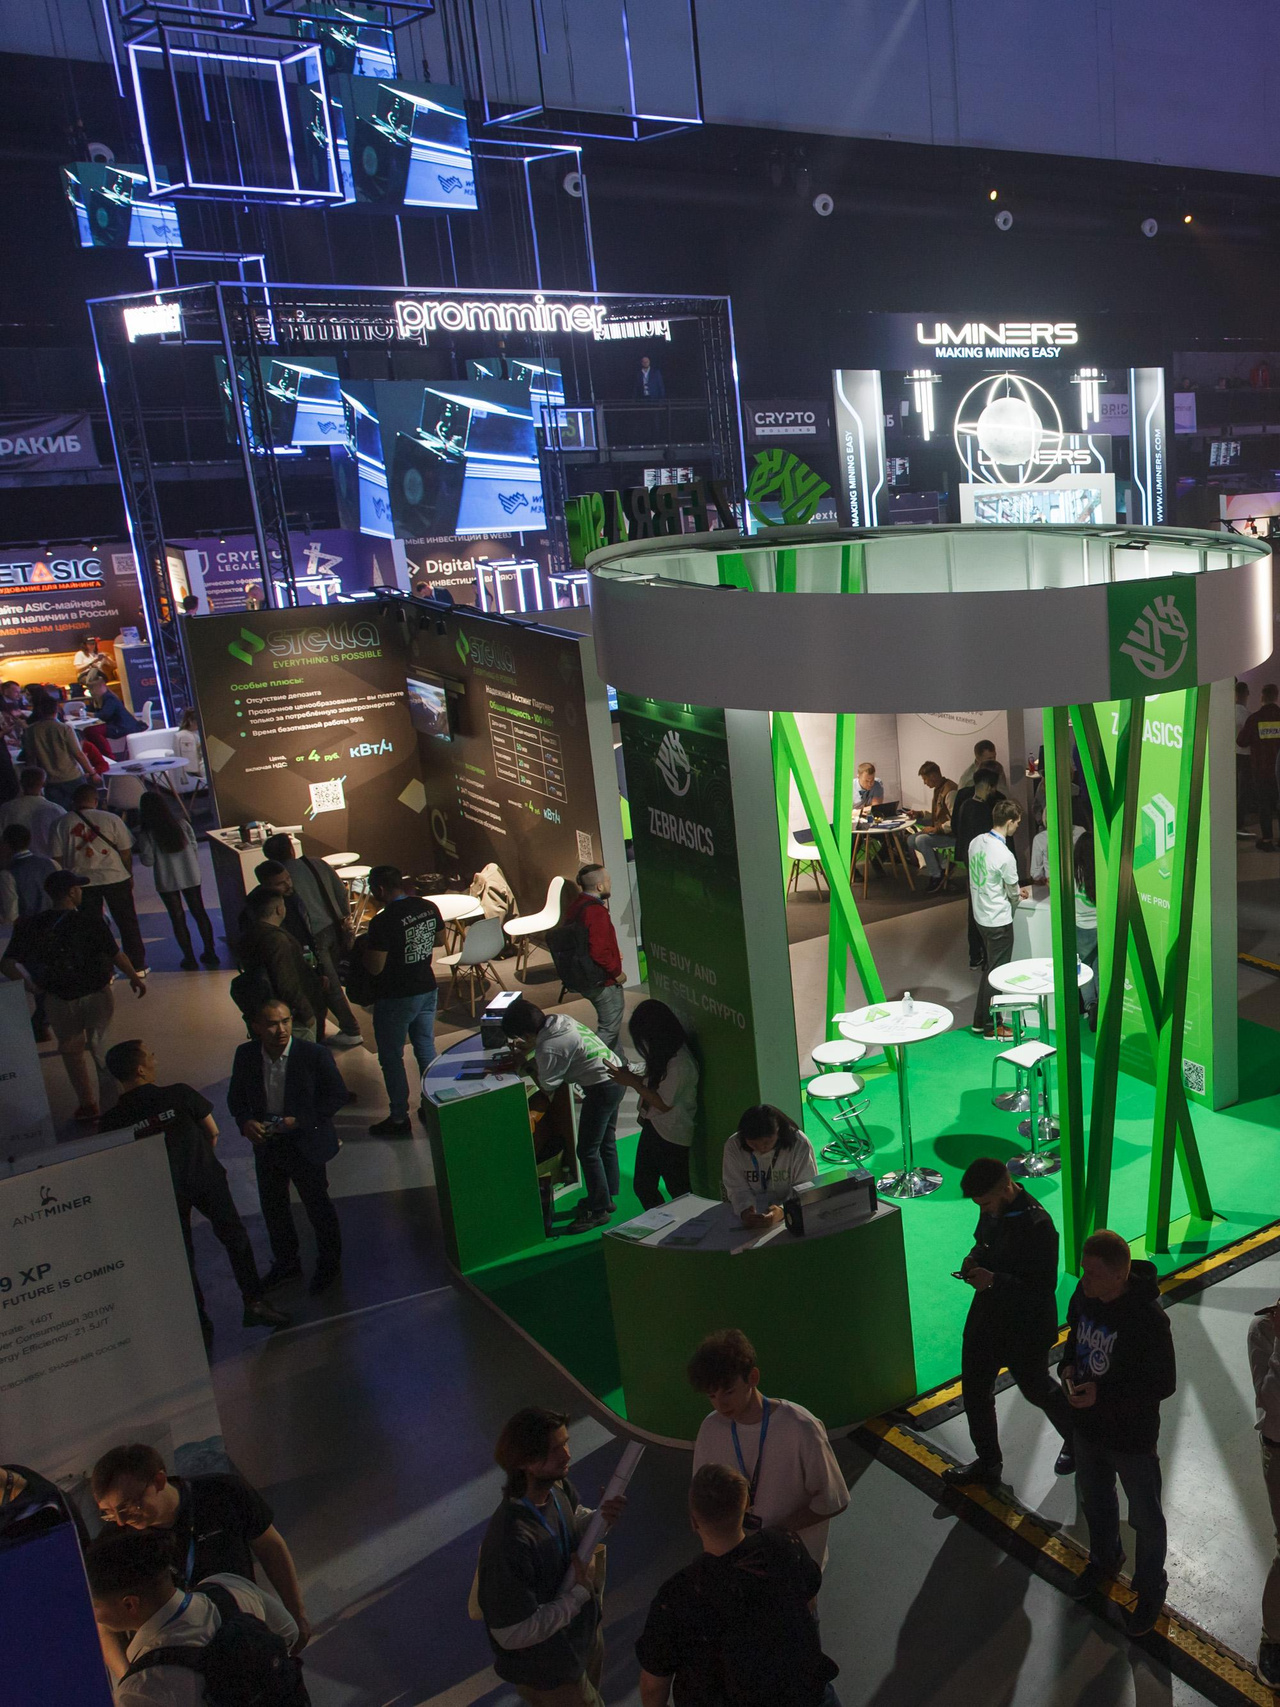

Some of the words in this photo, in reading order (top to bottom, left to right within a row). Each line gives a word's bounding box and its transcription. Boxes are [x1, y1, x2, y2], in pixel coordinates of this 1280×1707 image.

[395, 295, 606, 334] promminer
[916, 322, 1078, 345] UMINERS
[935, 347, 983, 358] MAKING
[985, 347, 1029, 358] MINING
[1032, 347, 1061, 358] EASY
[754, 411, 815, 425] CRYPTO
[0, 435, 81, 456] РАКИБ
[845, 431, 854, 453] EASY
[847, 455, 856, 489] MINING
[1154, 428, 1164, 523] WWW.UMINERS.COM
[850, 490, 859, 527] MAKING
[426, 534, 482, 545] ИНВЕСТИЦИИ
[218, 562, 261, 573] LEGALS
[425, 557, 476, 576] Digital
[21, 611, 70, 624] наличии
[80, 608, 119, 619] России
[25, 599, 106, 612] ASIC-майнеры
[55, 622, 91, 632] ценам
[273, 655, 330, 669] EVERYTHING
[341, 650, 383, 661] POSSIBLE
[230, 681, 268, 692] Особые
[270, 677, 305, 687] плюсы:
[246, 693, 287, 705] Отсутствие
[288, 690, 322, 700] депозита
[248, 705, 293, 716] Прозрачное
[294, 696, 358, 711] ценообразование
[377, 691, 404, 699] платите
[249, 716, 274, 725] только
[252, 727, 277, 737] Время
[277, 721, 323, 733] безотказной
[324, 718, 349, 728] работы
[349, 716, 365, 725] 99%
[1111, 711, 1183, 749] ZASICS
[308, 749, 321, 762] 4
[324, 752, 340, 763] руб.
[350, 738, 393, 758] кВт/ч
[648, 806, 714, 856] ZEBRASICS
[1141, 892, 1152, 905] WE
[650, 942, 667, 961] WE
[669, 951, 692, 974] BUY
[694, 963, 717, 986] AND
[652, 969, 670, 992] WE
[671, 980, 699, 1006] SELL
[701, 995, 746, 1029] CRYPTO
[12, 1195, 92, 1228] ANTMINER
[3, 1283, 55, 1309] FUTURE
[59, 1278, 71, 1289] IS
[74, 1260, 125, 1284] COMING
[19, 1263, 52, 1287] XP
[15, 1317, 79, 1345] Consumption
[82, 1303, 115, 1321] 3010W
[30, 1312, 54, 1326] 140T
